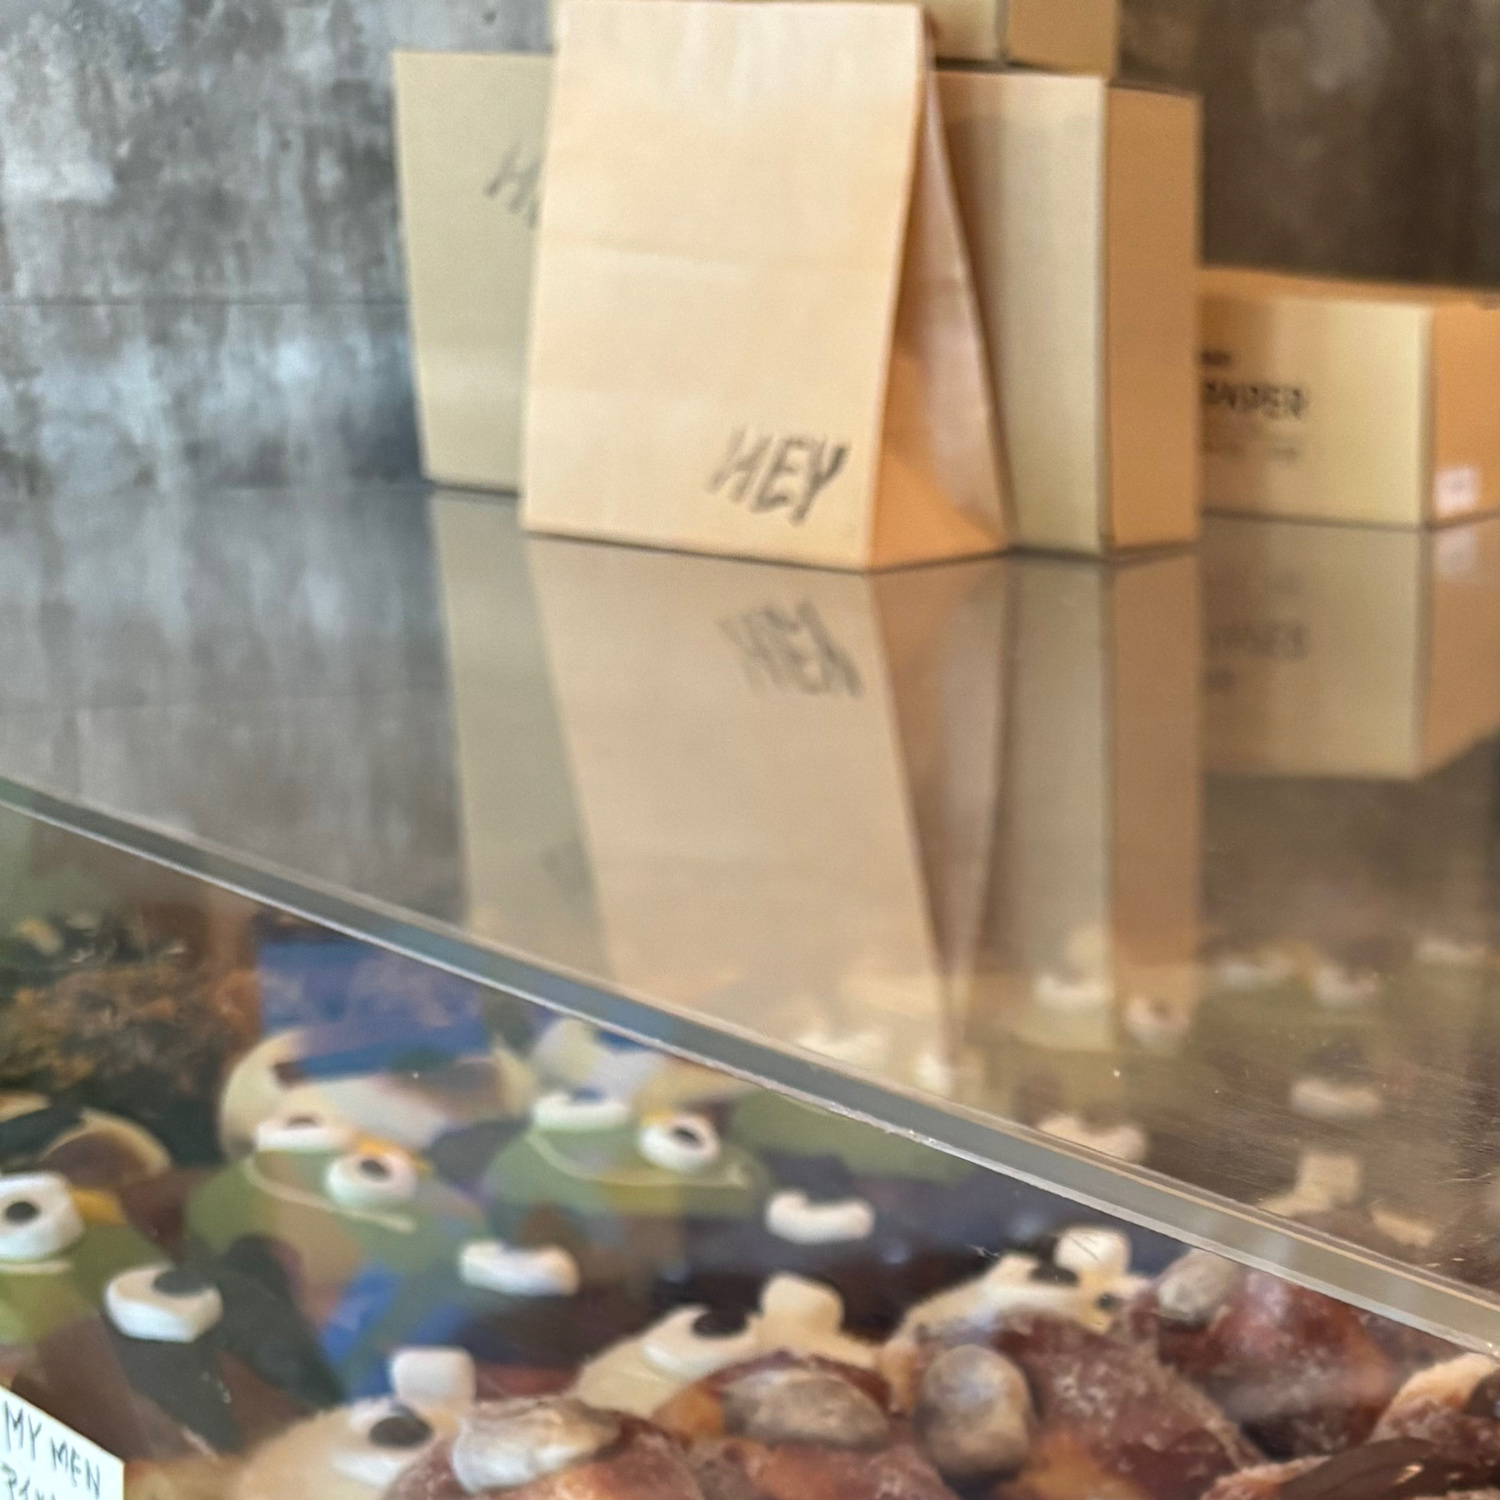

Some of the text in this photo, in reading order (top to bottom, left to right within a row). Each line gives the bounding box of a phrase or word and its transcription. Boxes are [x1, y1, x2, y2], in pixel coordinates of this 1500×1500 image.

[705, 424, 851, 526] HEY
[2, 1400, 100, 1500] MY MEN
